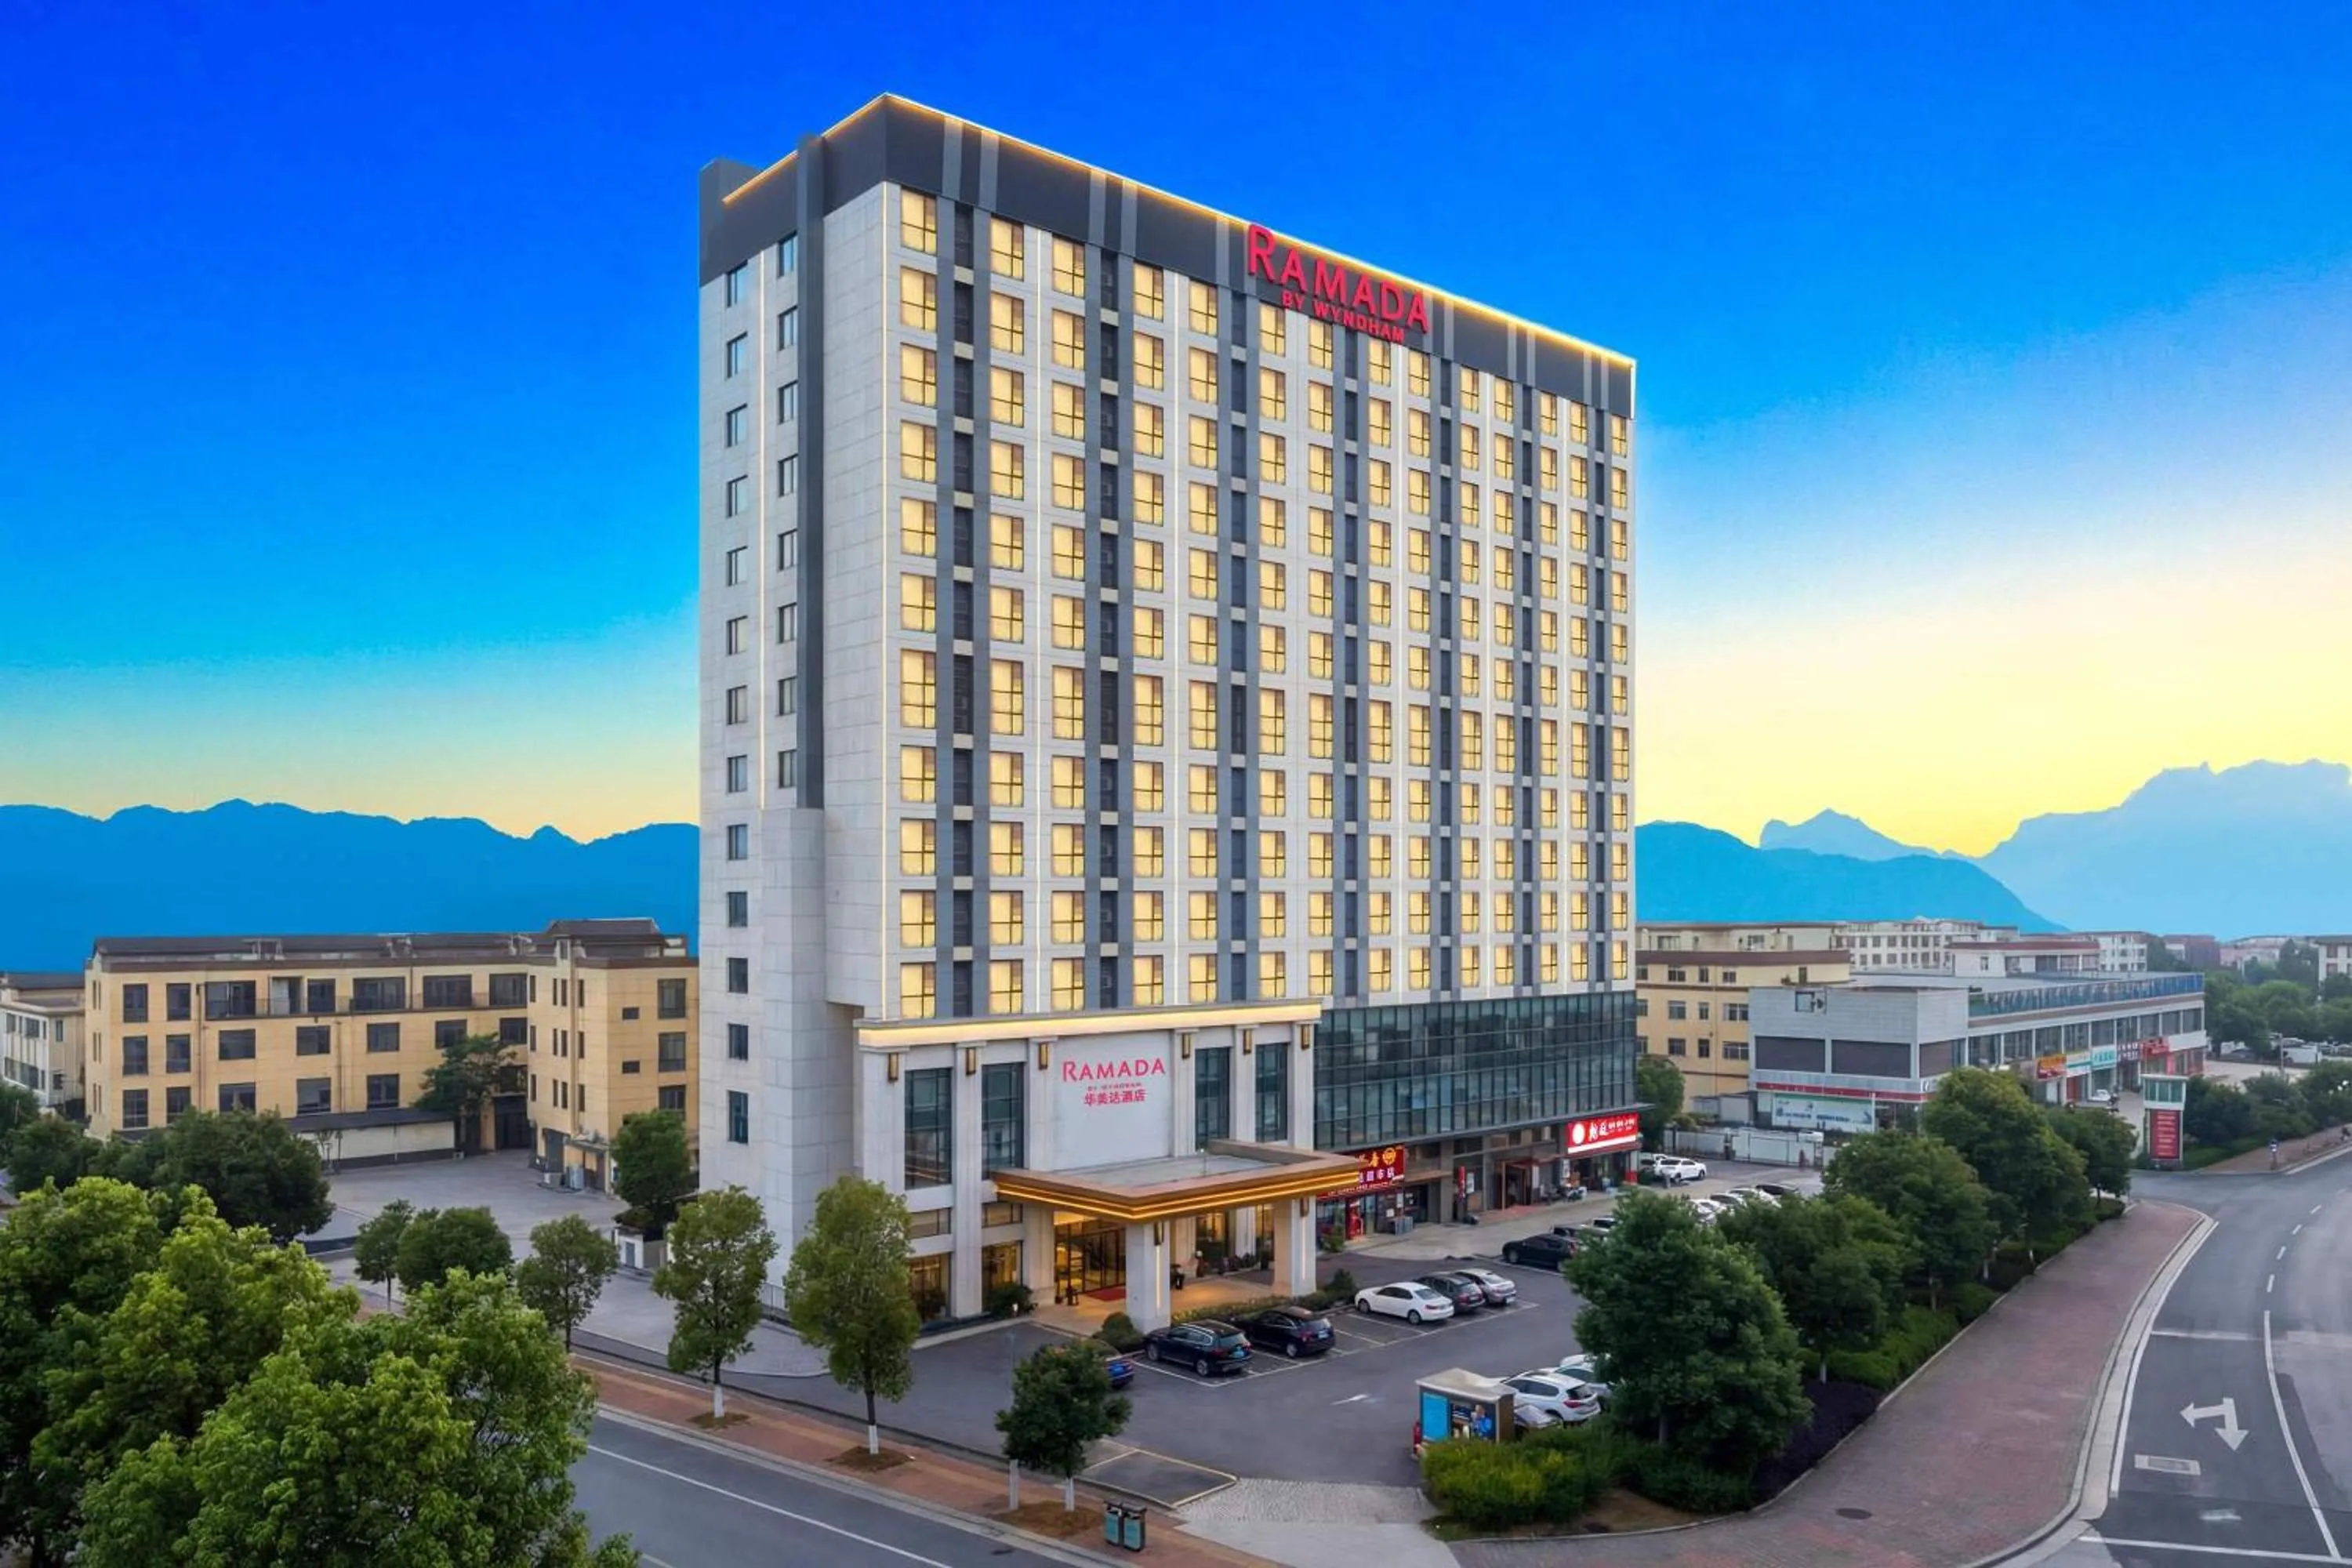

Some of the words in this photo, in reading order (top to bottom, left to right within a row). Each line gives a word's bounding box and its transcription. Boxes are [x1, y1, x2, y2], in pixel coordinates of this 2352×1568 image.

[1247, 223, 1428, 334] RAMADA
[1281, 289, 1305, 310] BY
[1312, 299, 1405, 343] WYNDHAM
[1062, 1058, 1166, 1082] RAMADA
